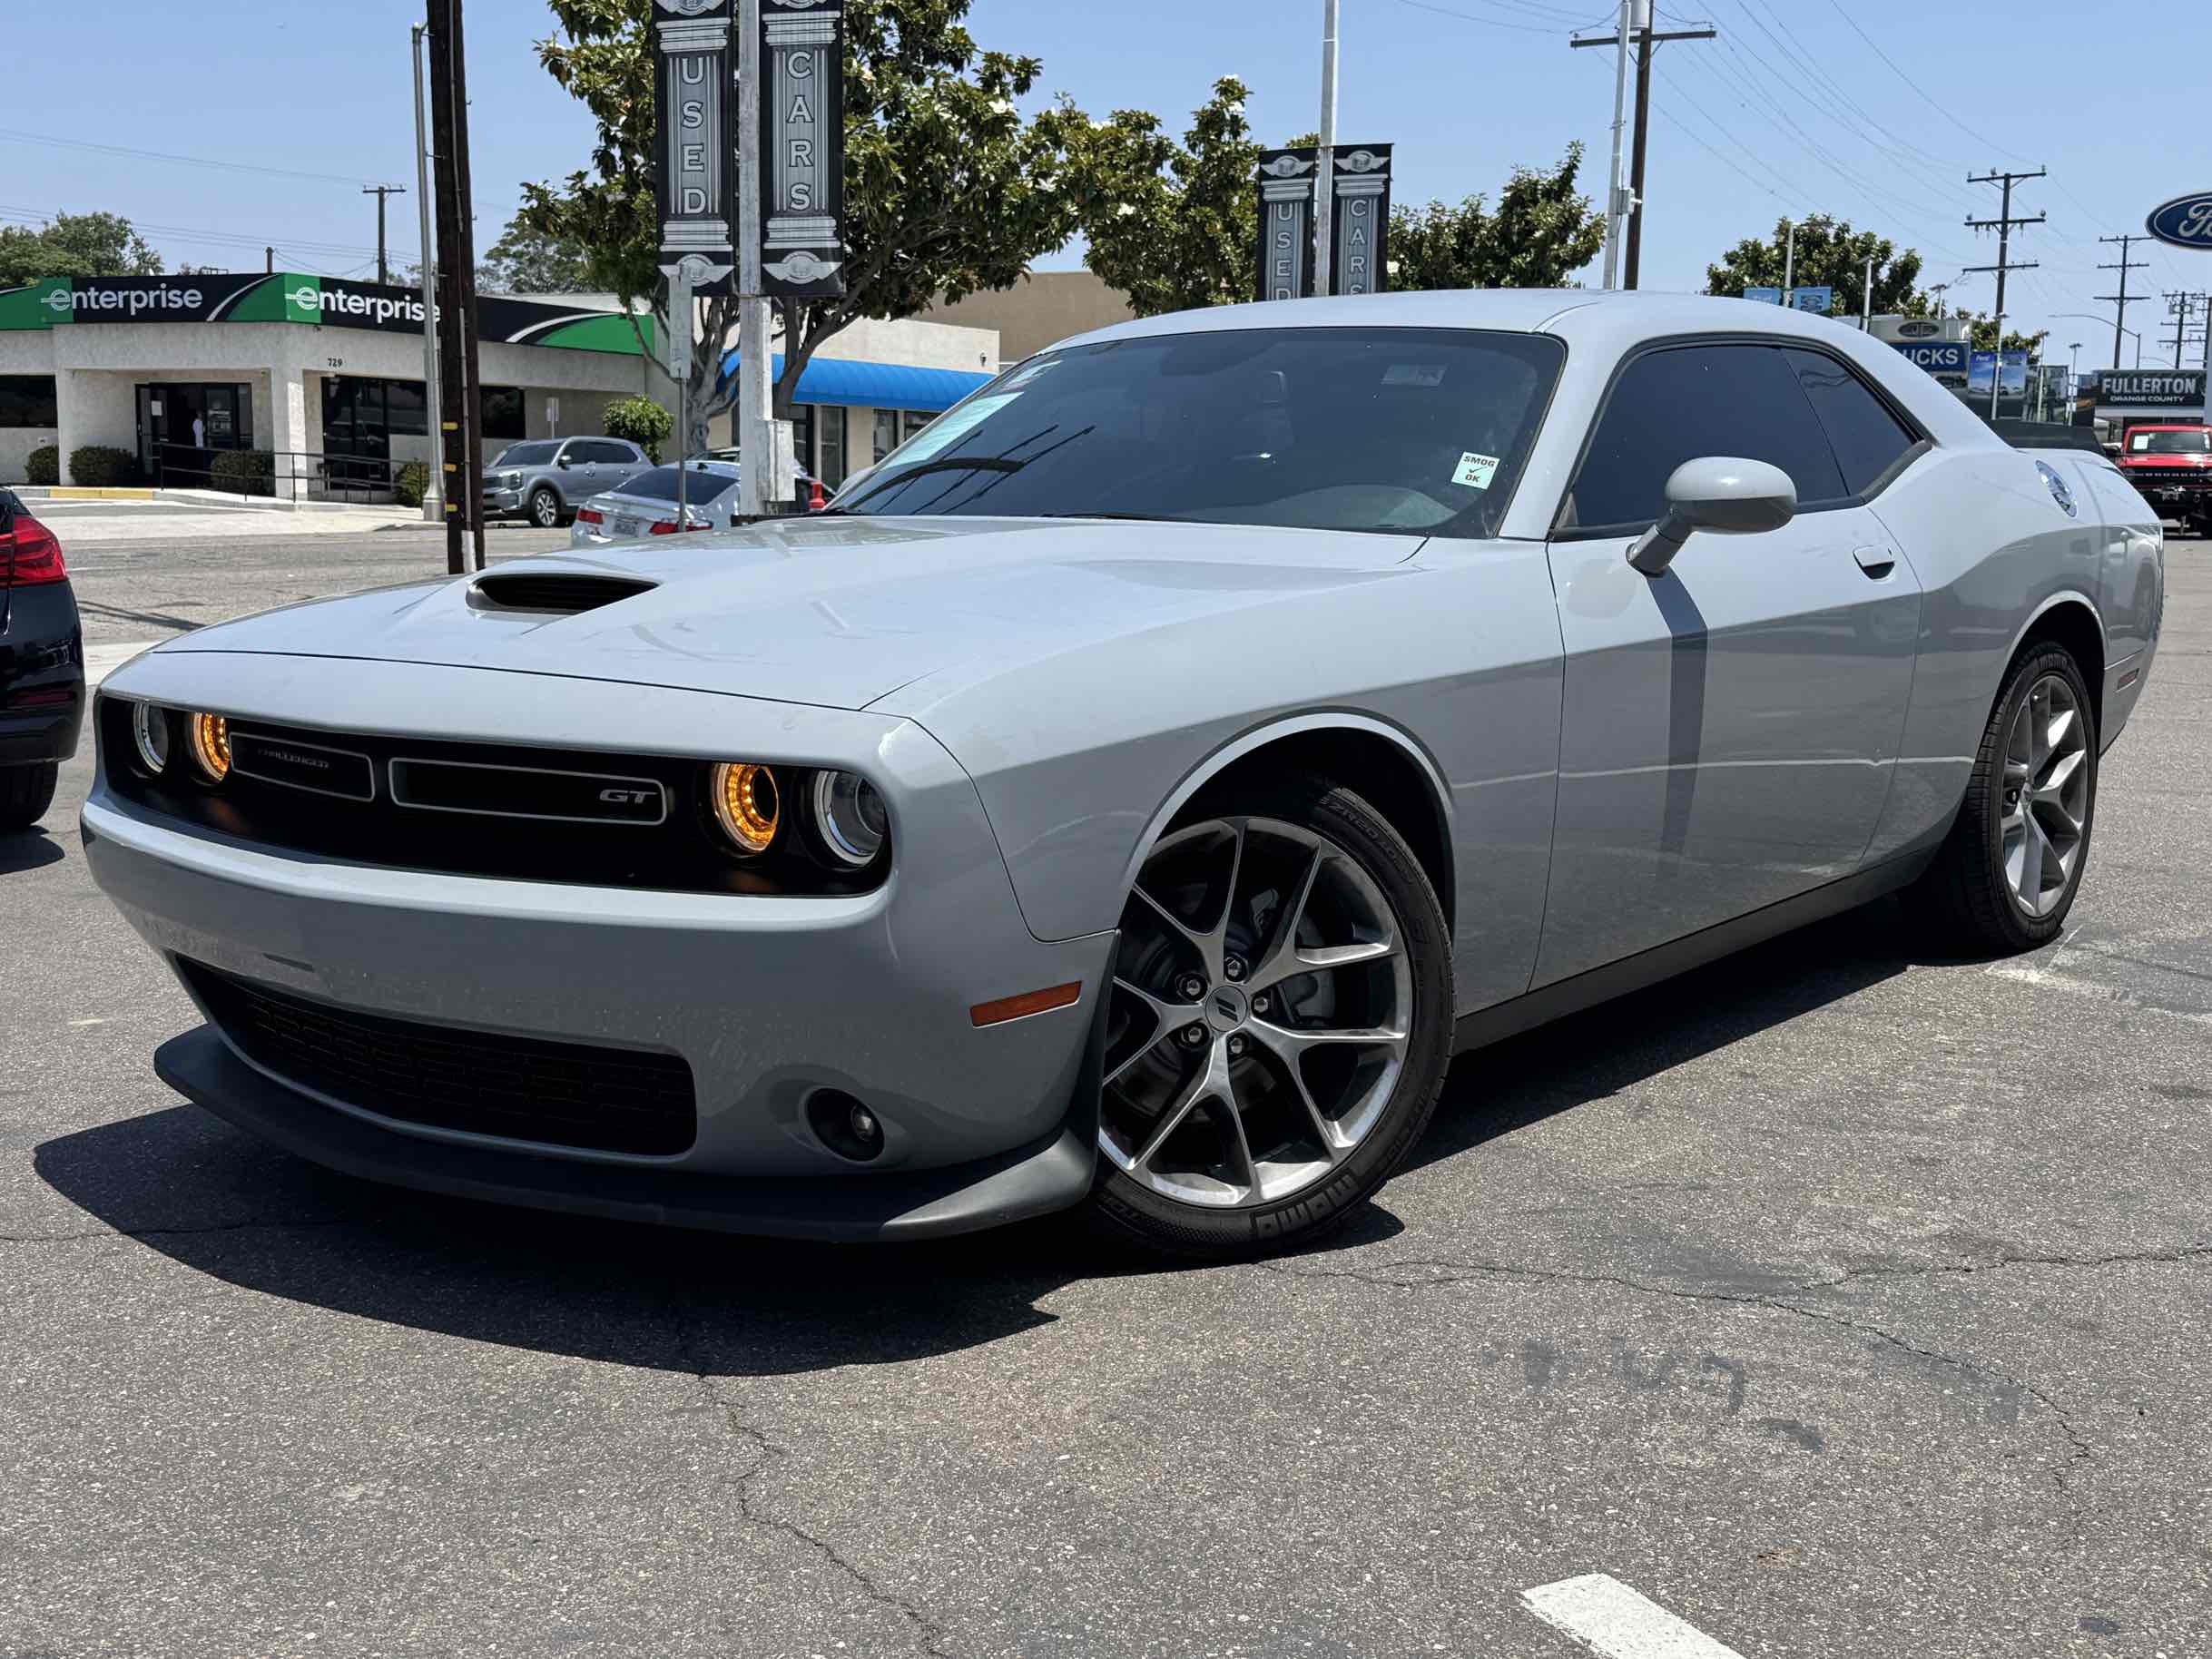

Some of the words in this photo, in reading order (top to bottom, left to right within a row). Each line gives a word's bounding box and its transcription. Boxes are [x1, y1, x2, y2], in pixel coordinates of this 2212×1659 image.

[682, 56, 706, 215] USED
[787, 50, 814, 211] CARS
[1275, 203, 1293, 300] USED
[41, 283, 203, 316] enterprise
[328, 358, 343, 368] 729
[2101, 378, 2196, 394] FULLERTON
[1463, 456, 1496, 466] SMOG
[1465, 474, 1481, 482] OK
[600, 789, 657, 804] GT
